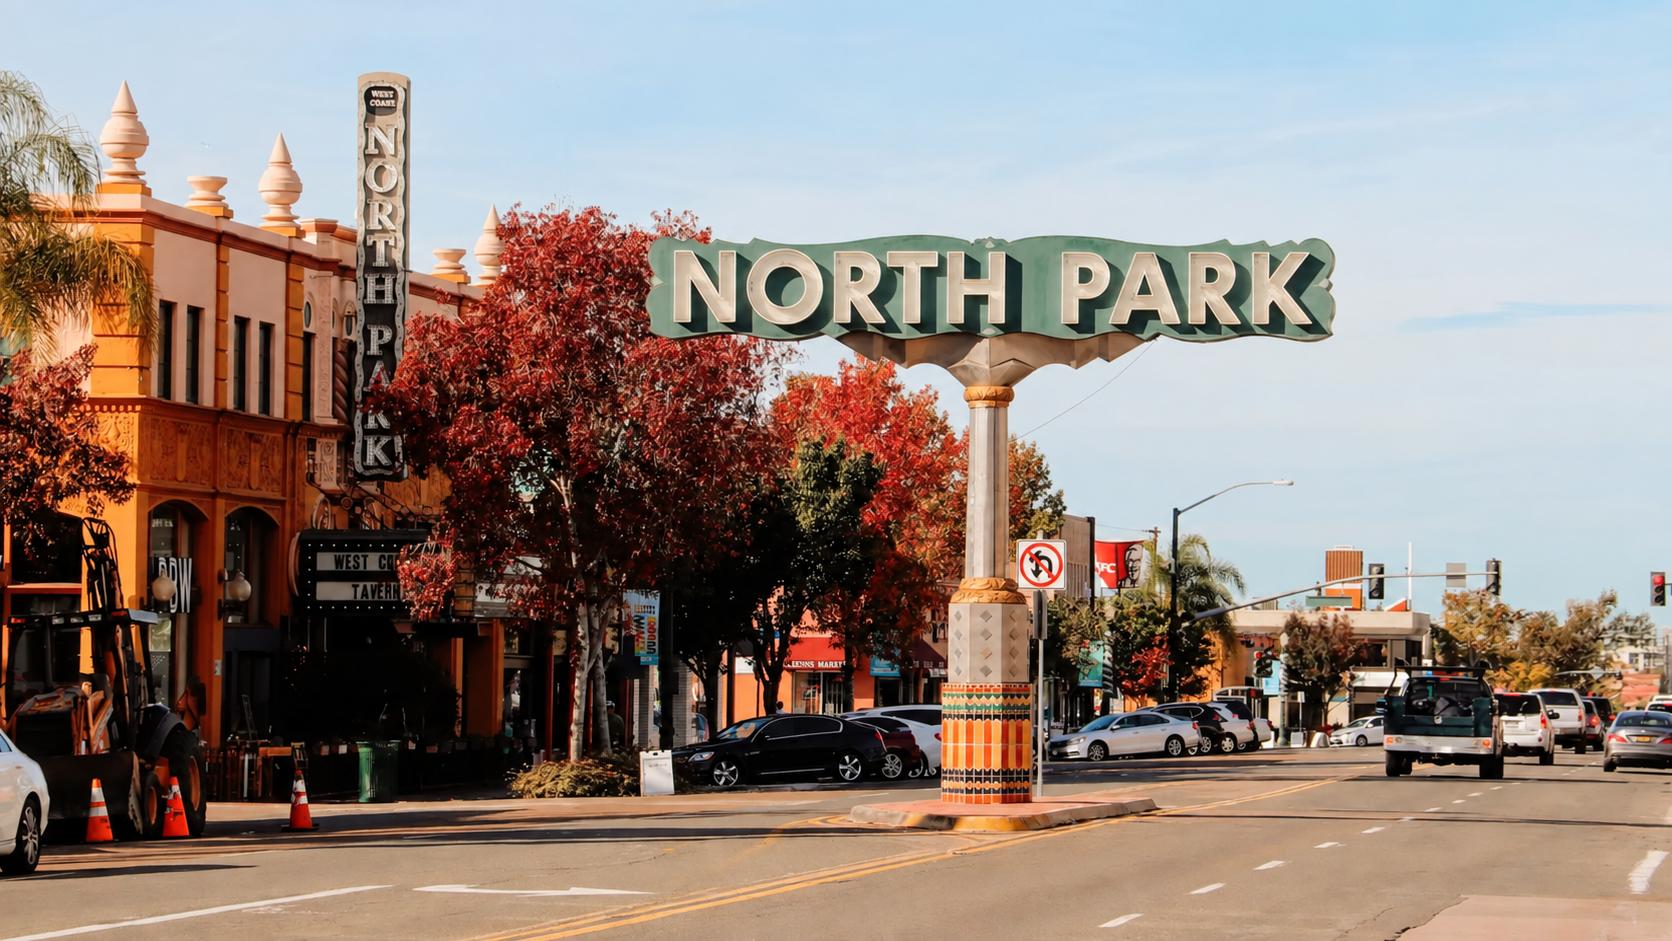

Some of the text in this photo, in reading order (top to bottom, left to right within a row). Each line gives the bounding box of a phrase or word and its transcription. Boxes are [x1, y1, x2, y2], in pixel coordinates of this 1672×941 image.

[364, 124, 398, 304] NORTH
[673, 248, 1312, 325] NORTH PARK
[334, 554, 399, 570] WEST CO
